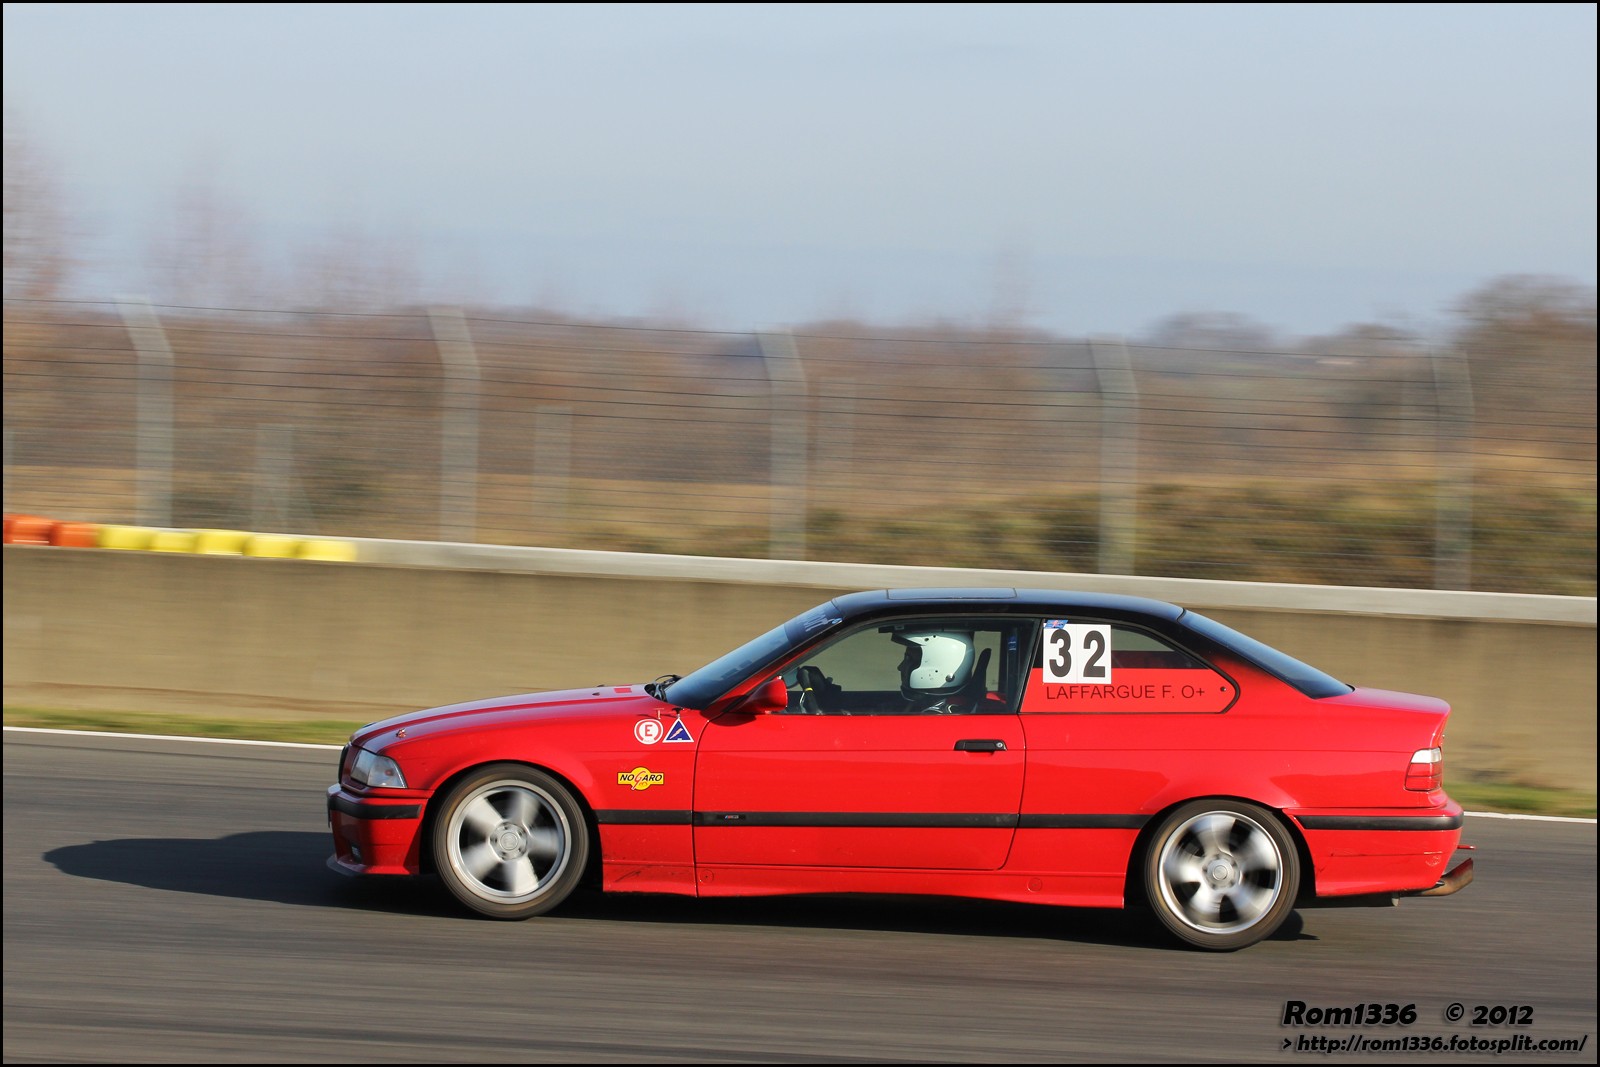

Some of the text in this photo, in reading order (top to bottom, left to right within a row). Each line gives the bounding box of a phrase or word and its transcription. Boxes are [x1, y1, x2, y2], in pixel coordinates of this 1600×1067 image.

[1048, 628, 1107, 678] 32
[1046, 684, 1206, 700] LAFFARGUE F. O+
[644, 724, 653, 737] E
[619, 771, 663, 788] NOGARO
